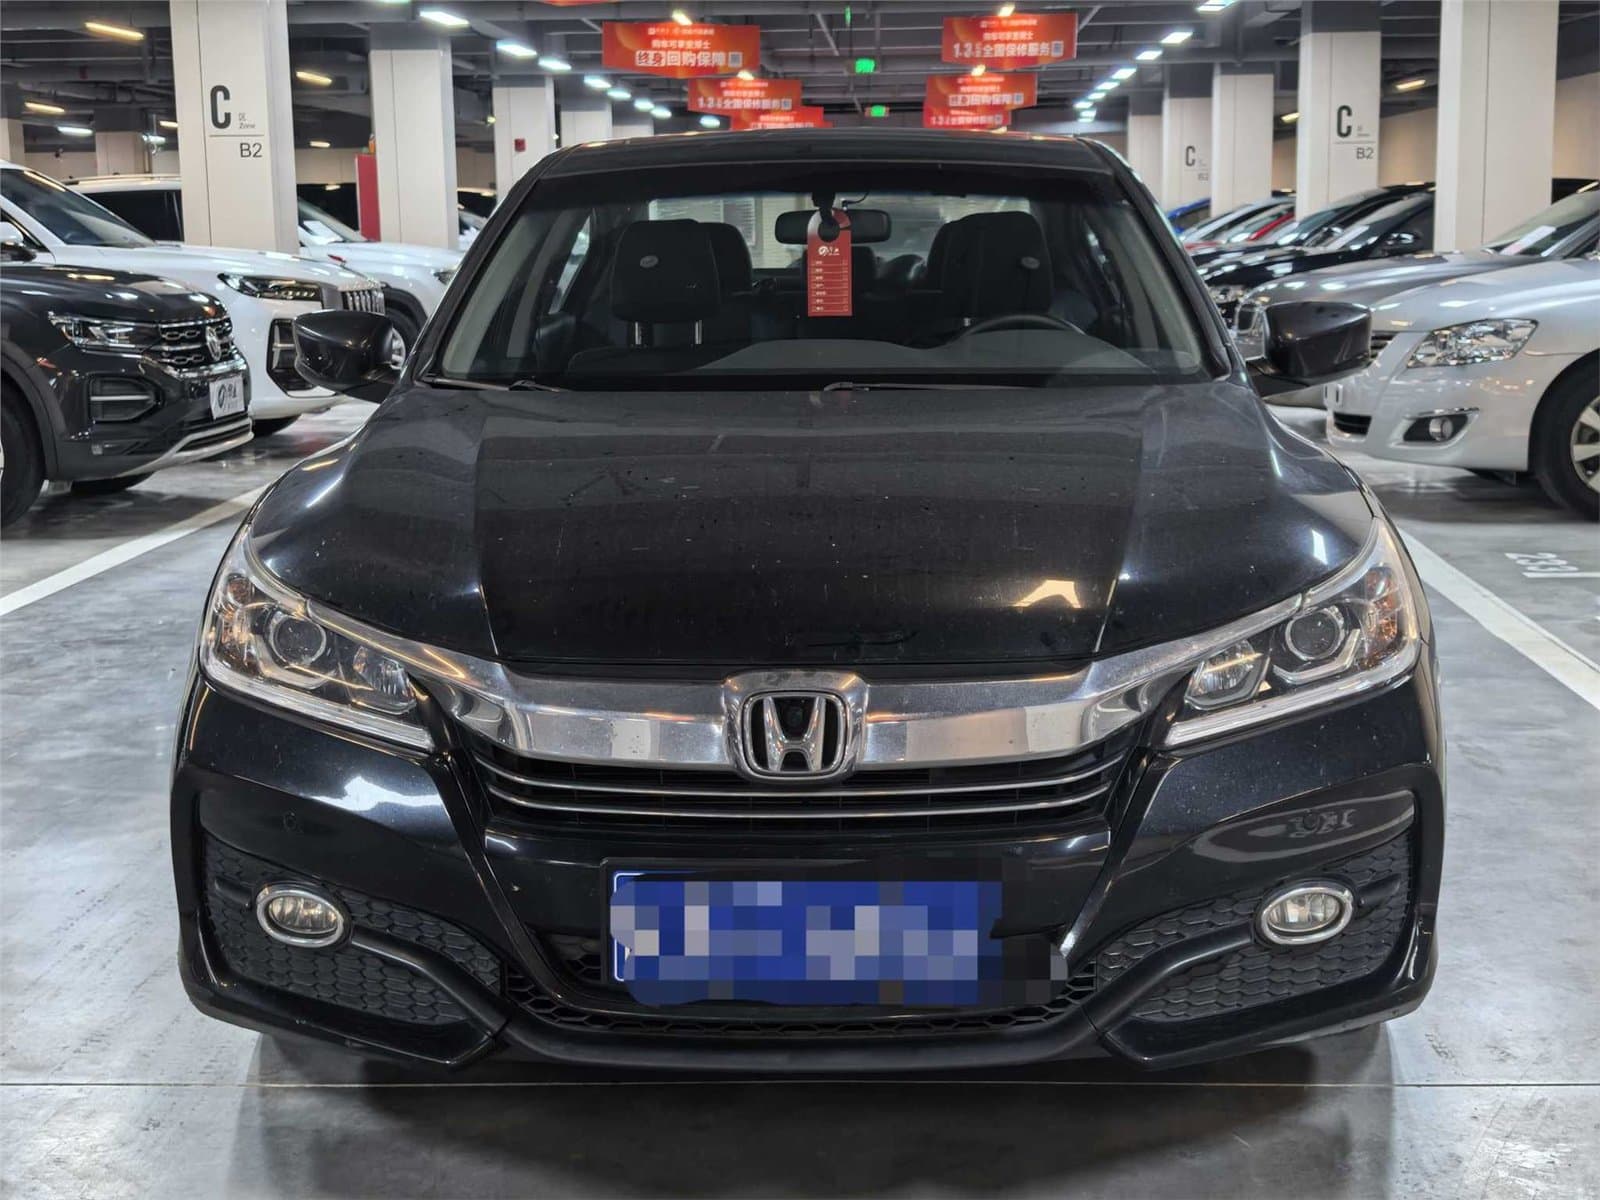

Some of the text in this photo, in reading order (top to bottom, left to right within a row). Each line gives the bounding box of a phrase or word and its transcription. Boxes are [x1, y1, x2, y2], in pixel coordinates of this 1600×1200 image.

[210, 85, 231, 129] C
[1337, 105, 1352, 137] C
[240, 143, 263, 158] B2
[1185, 146, 1195, 167] C
[1356, 148, 1374, 160] B2
